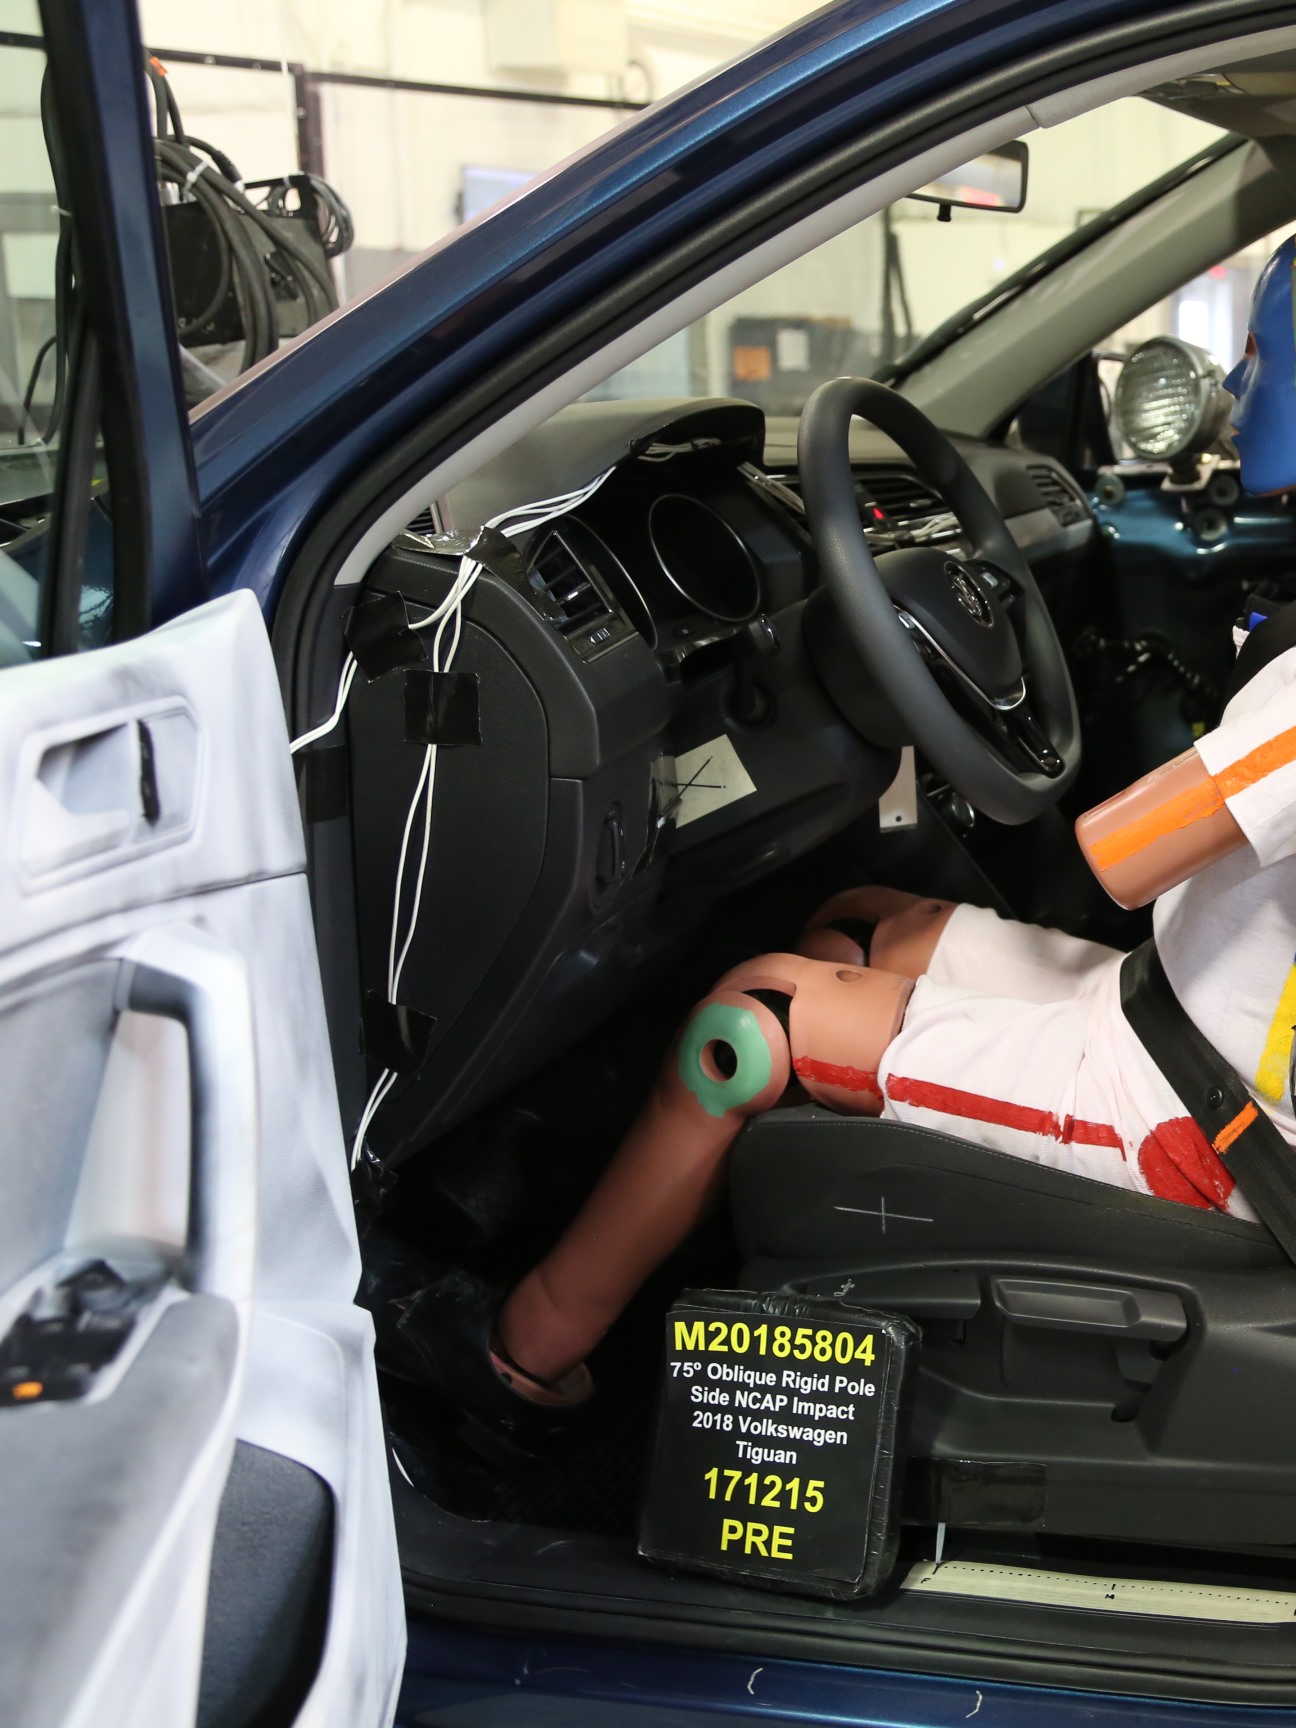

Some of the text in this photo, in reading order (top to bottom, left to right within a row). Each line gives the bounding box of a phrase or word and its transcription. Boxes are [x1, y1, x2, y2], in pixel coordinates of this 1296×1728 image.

[674, 1321, 876, 1367] M20185804
[707, 1363, 777, 1389] Oblique
[782, 1371, 830, 1395] Rigid
[835, 1376, 876, 1397] Pole
[690, 1386, 856, 1421] Side NCAP Impact
[692, 1411, 849, 1447] 2018 Volkswagen
[736, 1441, 798, 1465] Tiguan
[704, 1467, 826, 1514] 171215
[721, 1519, 796, 1560] PRE
